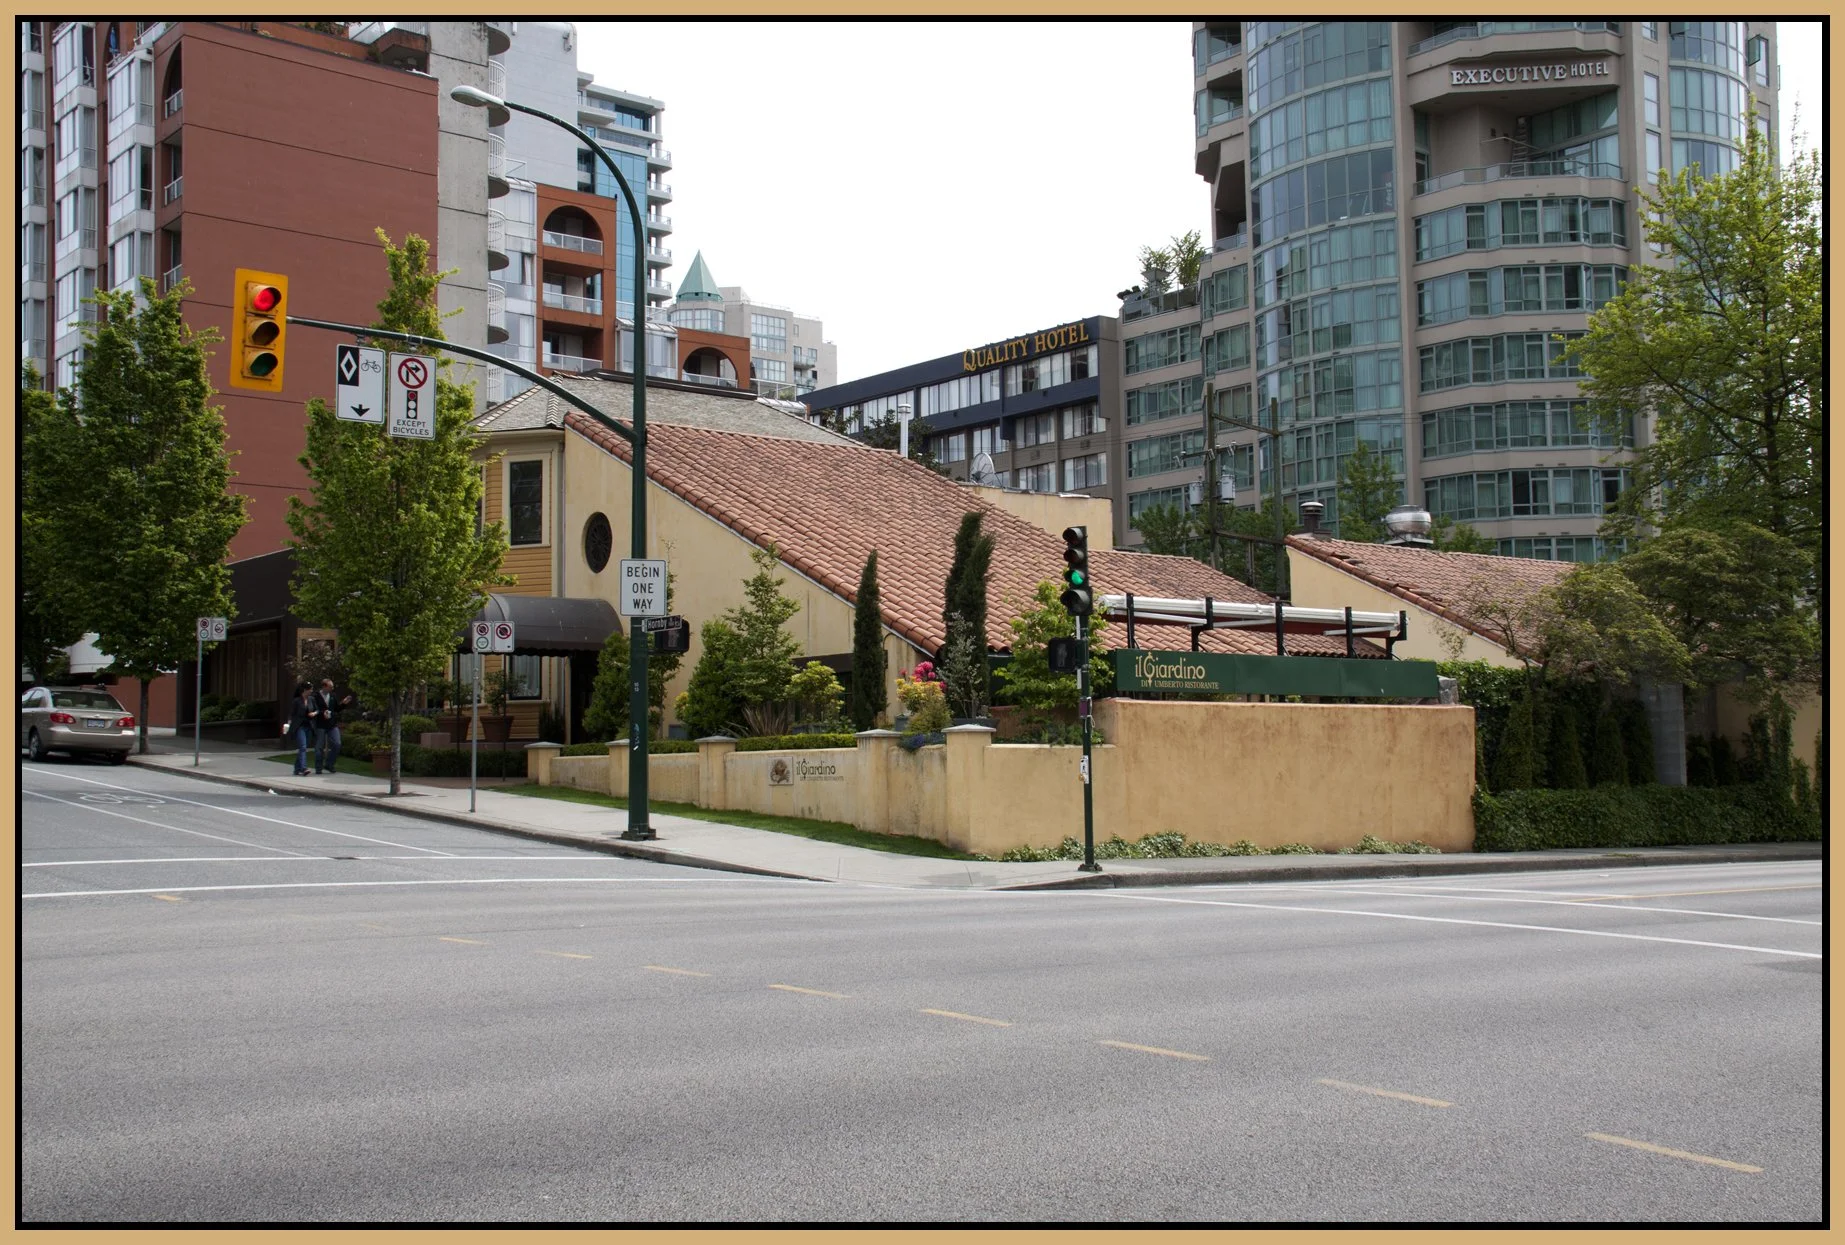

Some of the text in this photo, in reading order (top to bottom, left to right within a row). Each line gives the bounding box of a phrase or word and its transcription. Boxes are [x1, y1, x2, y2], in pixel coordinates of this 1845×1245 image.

[1451, 62, 1609, 85] EXECUTIVE HOTEL
[963, 323, 1089, 371] QUALITY HOTEL
[397, 419, 426, 428] EXCEPT
[394, 427, 429, 435] BICYCLES
[627, 567, 660, 578] BEGIN
[632, 583, 654, 593] ONE
[633, 598, 653, 610] WAY
[1155, 680, 1184, 688] UMBERTO
[1185, 681, 1220, 690] RISTORANTE
